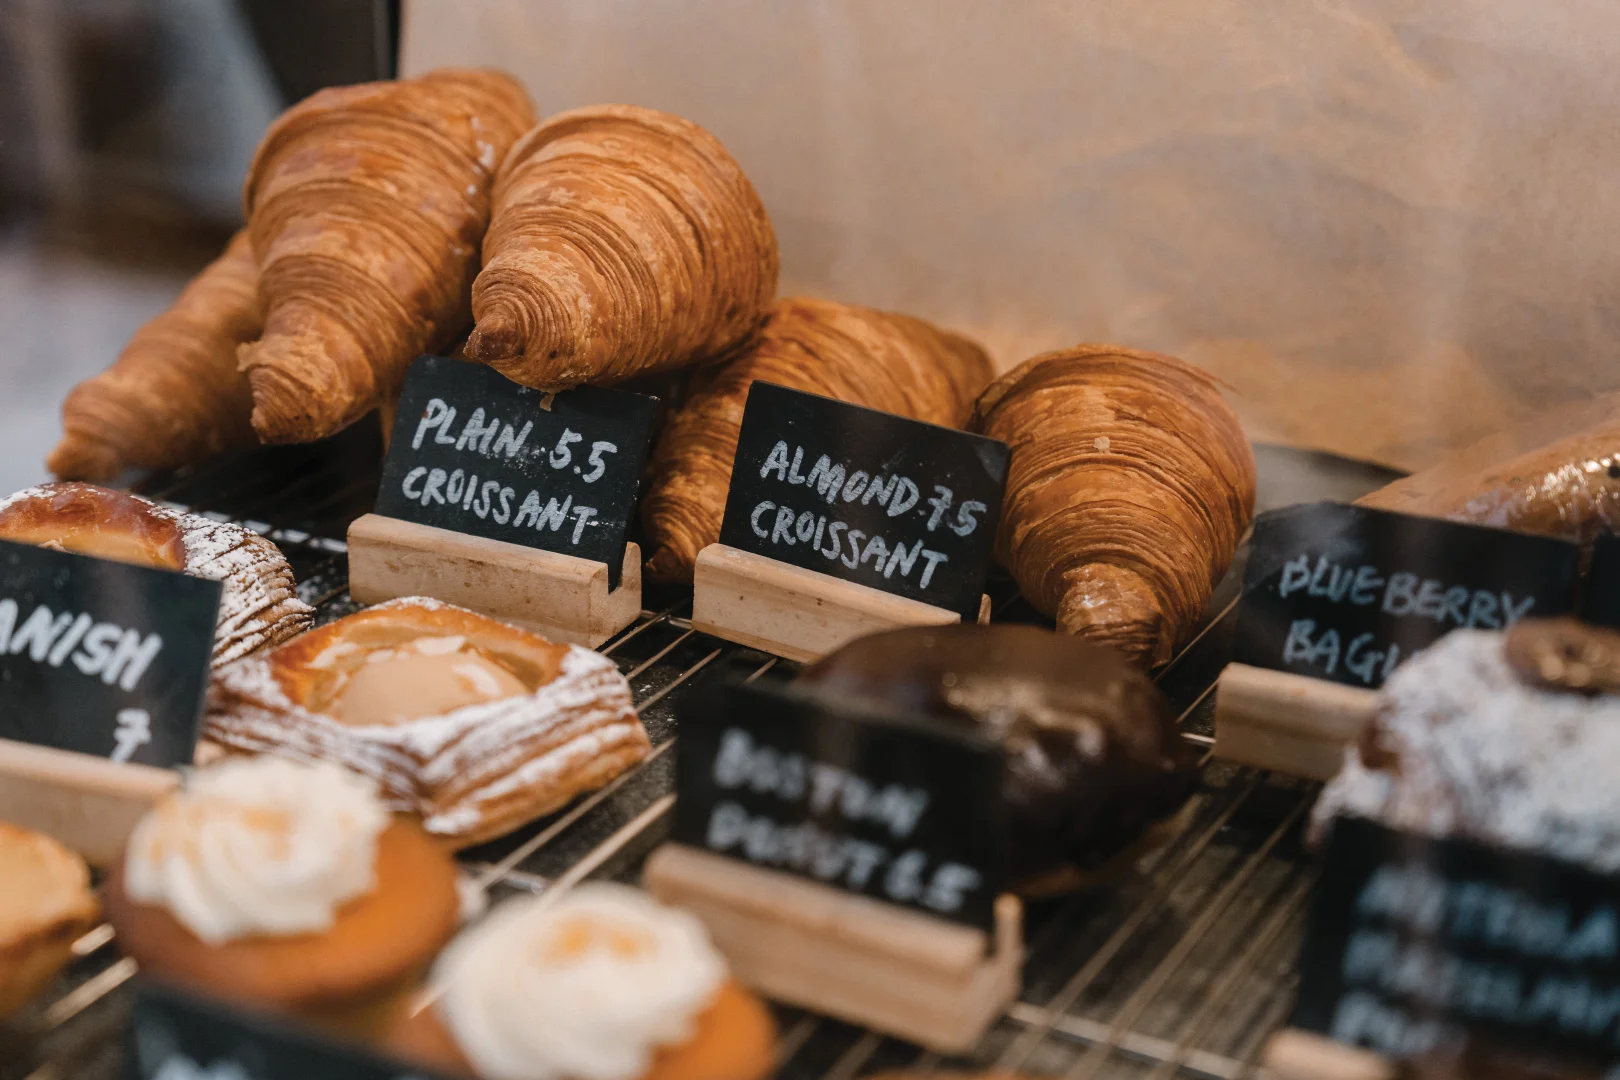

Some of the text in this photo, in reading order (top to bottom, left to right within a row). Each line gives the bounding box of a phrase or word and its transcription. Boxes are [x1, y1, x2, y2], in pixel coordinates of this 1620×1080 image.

[411, 397, 618, 484] PLAIN 5.5
[759, 439, 921, 518] ALMOND
[401, 465, 598, 546] CROISSANT
[750, 499, 950, 590] CROISSANT
[109, 707, 152, 763] 7
